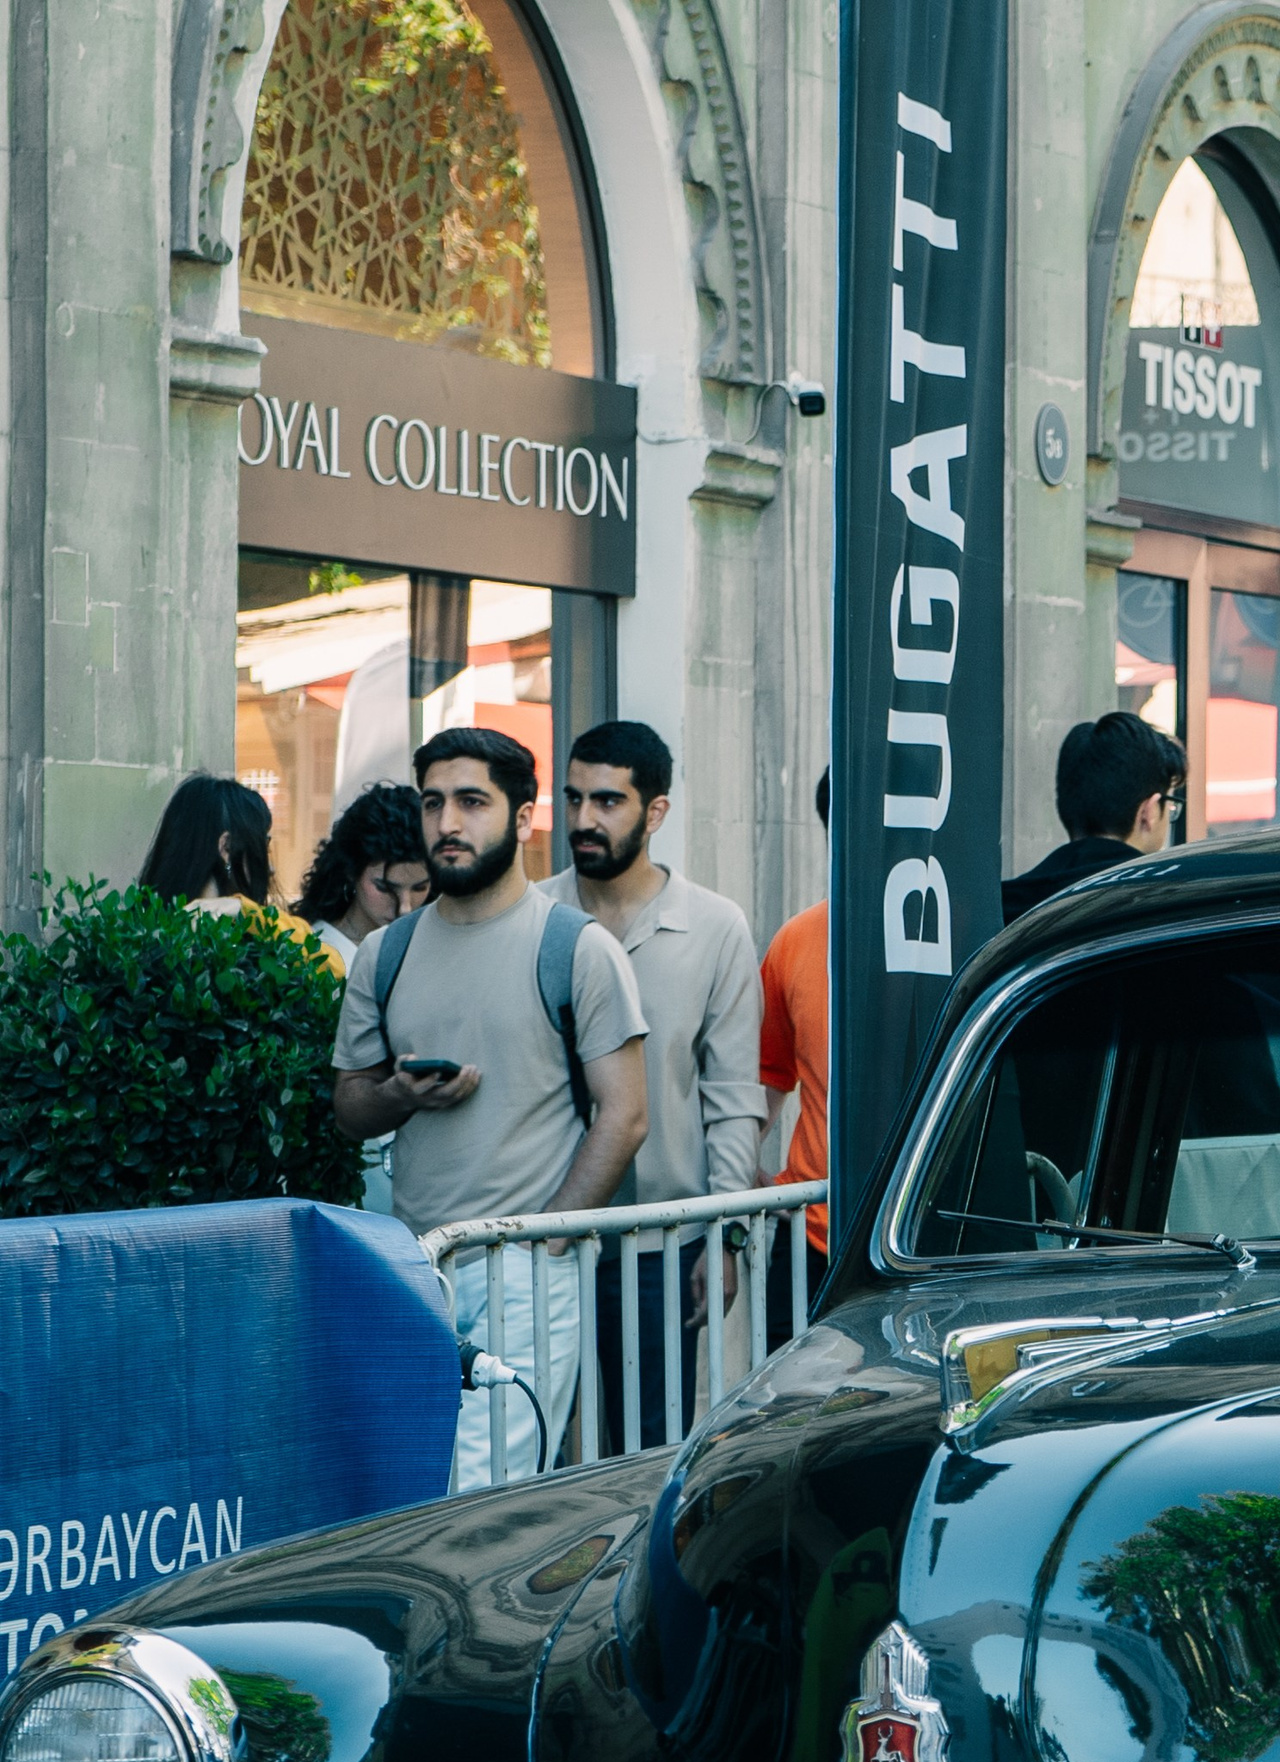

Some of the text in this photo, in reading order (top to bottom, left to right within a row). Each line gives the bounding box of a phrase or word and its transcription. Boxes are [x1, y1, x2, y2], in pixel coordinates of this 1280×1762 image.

[1138, 340, 1263, 429] TISSOT
[237, 392, 629, 522] OYAL COLLECTION
[884, 91, 968, 977] BUGATTI
